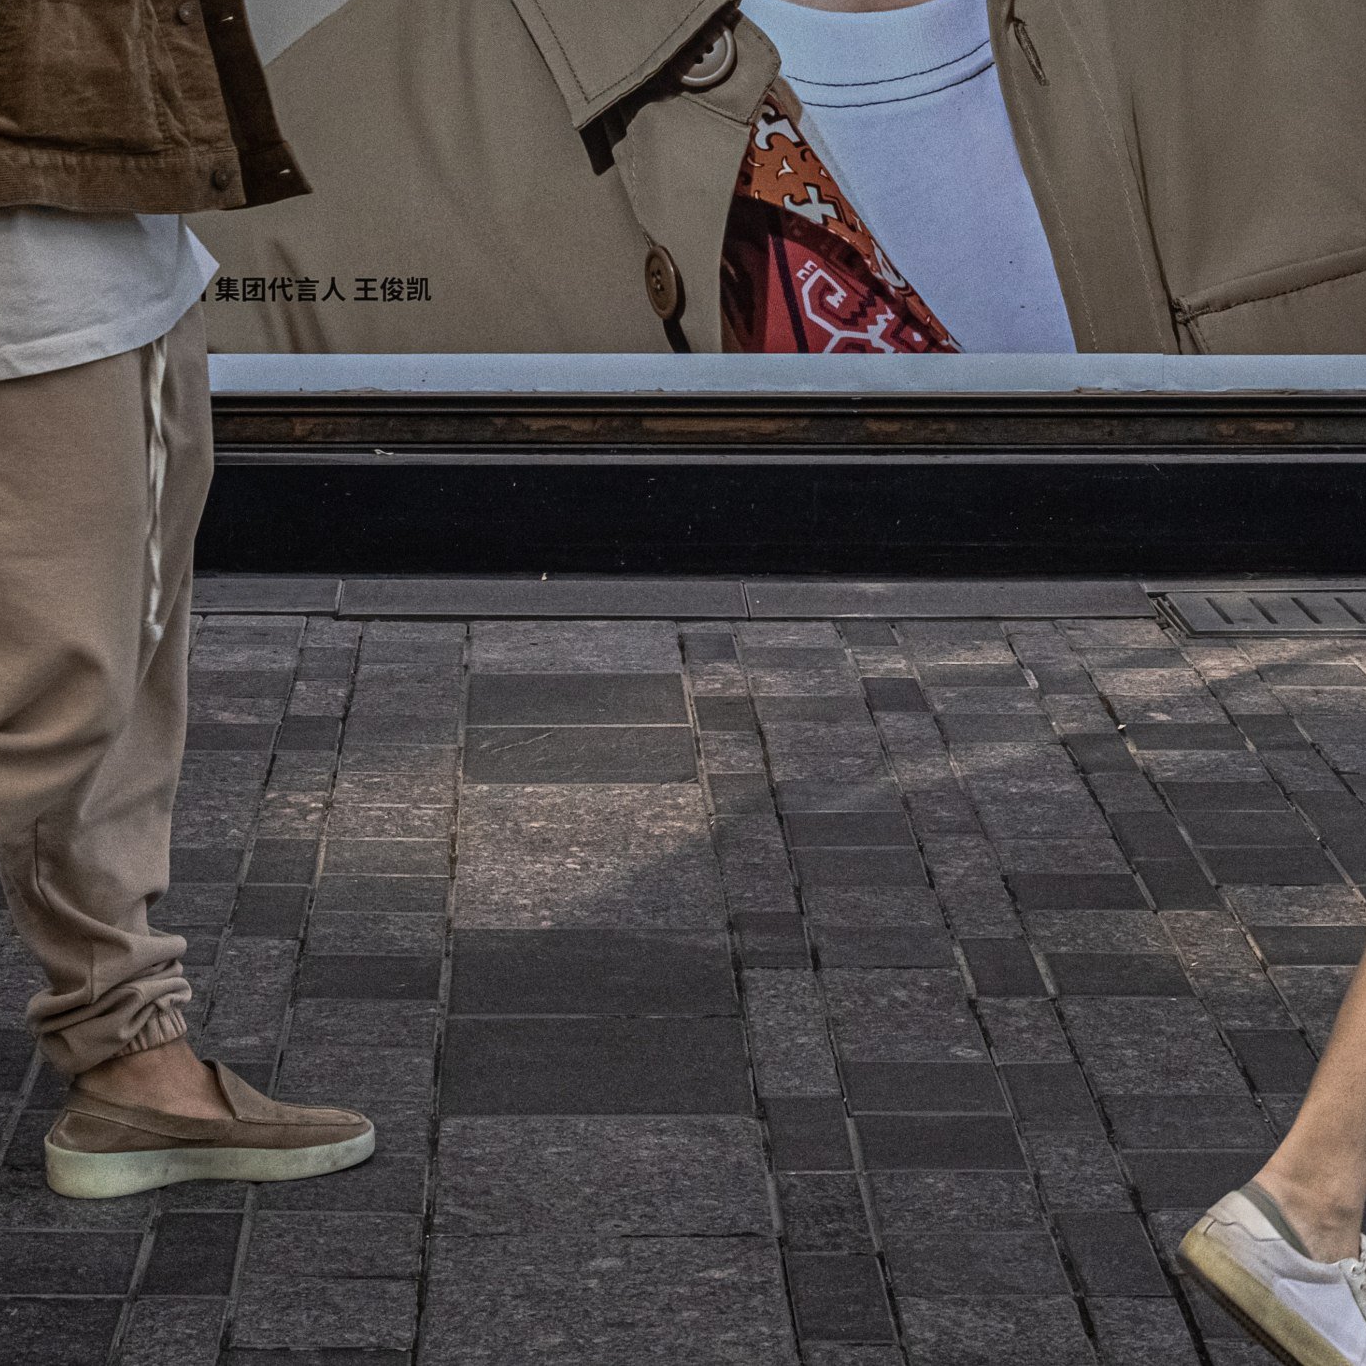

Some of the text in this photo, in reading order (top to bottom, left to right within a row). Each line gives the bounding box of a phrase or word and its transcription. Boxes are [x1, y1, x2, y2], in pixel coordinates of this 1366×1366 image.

[215, 276, 346, 302] 集团代言人
[354, 276, 432, 302] 王俊凯
